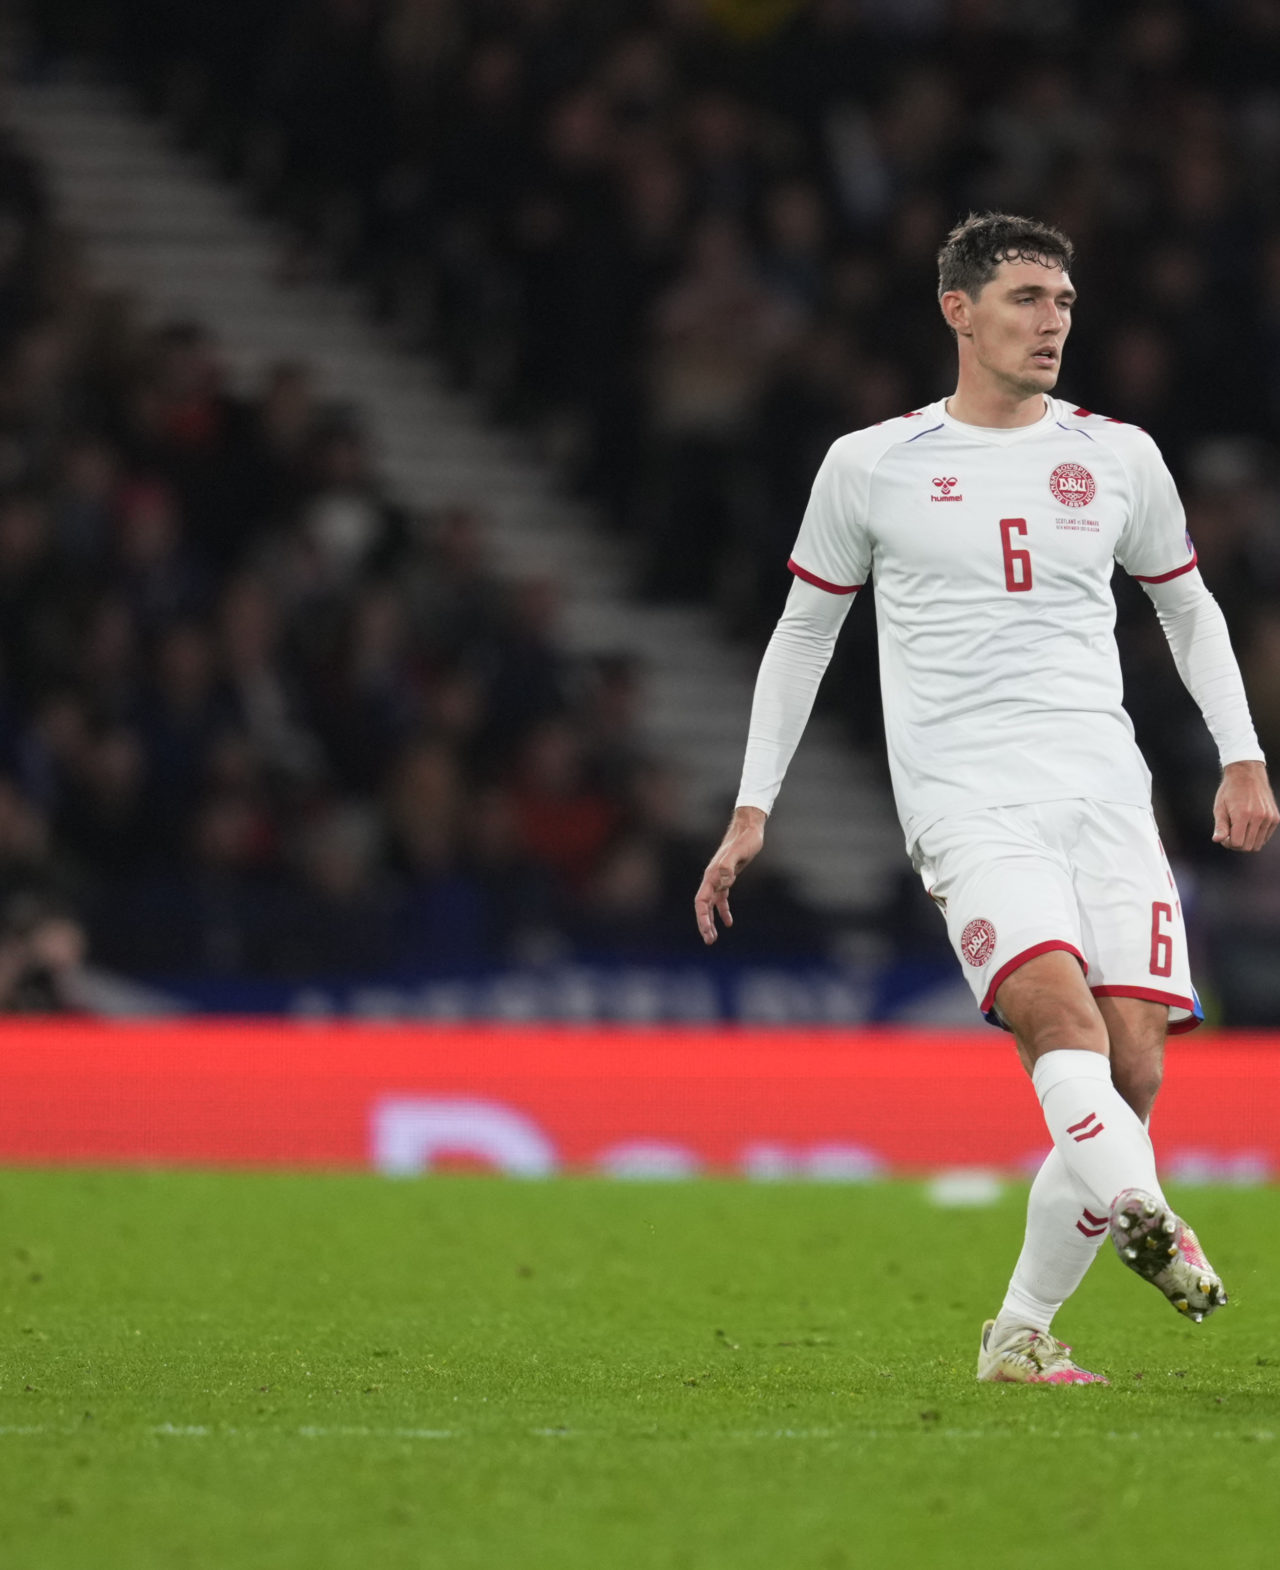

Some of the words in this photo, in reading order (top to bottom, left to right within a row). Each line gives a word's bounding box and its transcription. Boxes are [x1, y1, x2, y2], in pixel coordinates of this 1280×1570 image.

[931, 494, 963, 502] hummel
[1059, 478, 1087, 492] DBU
[999, 517, 1033, 593] 6
[967, 929, 989, 957] DBU
[1149, 901, 1172, 978] 6
